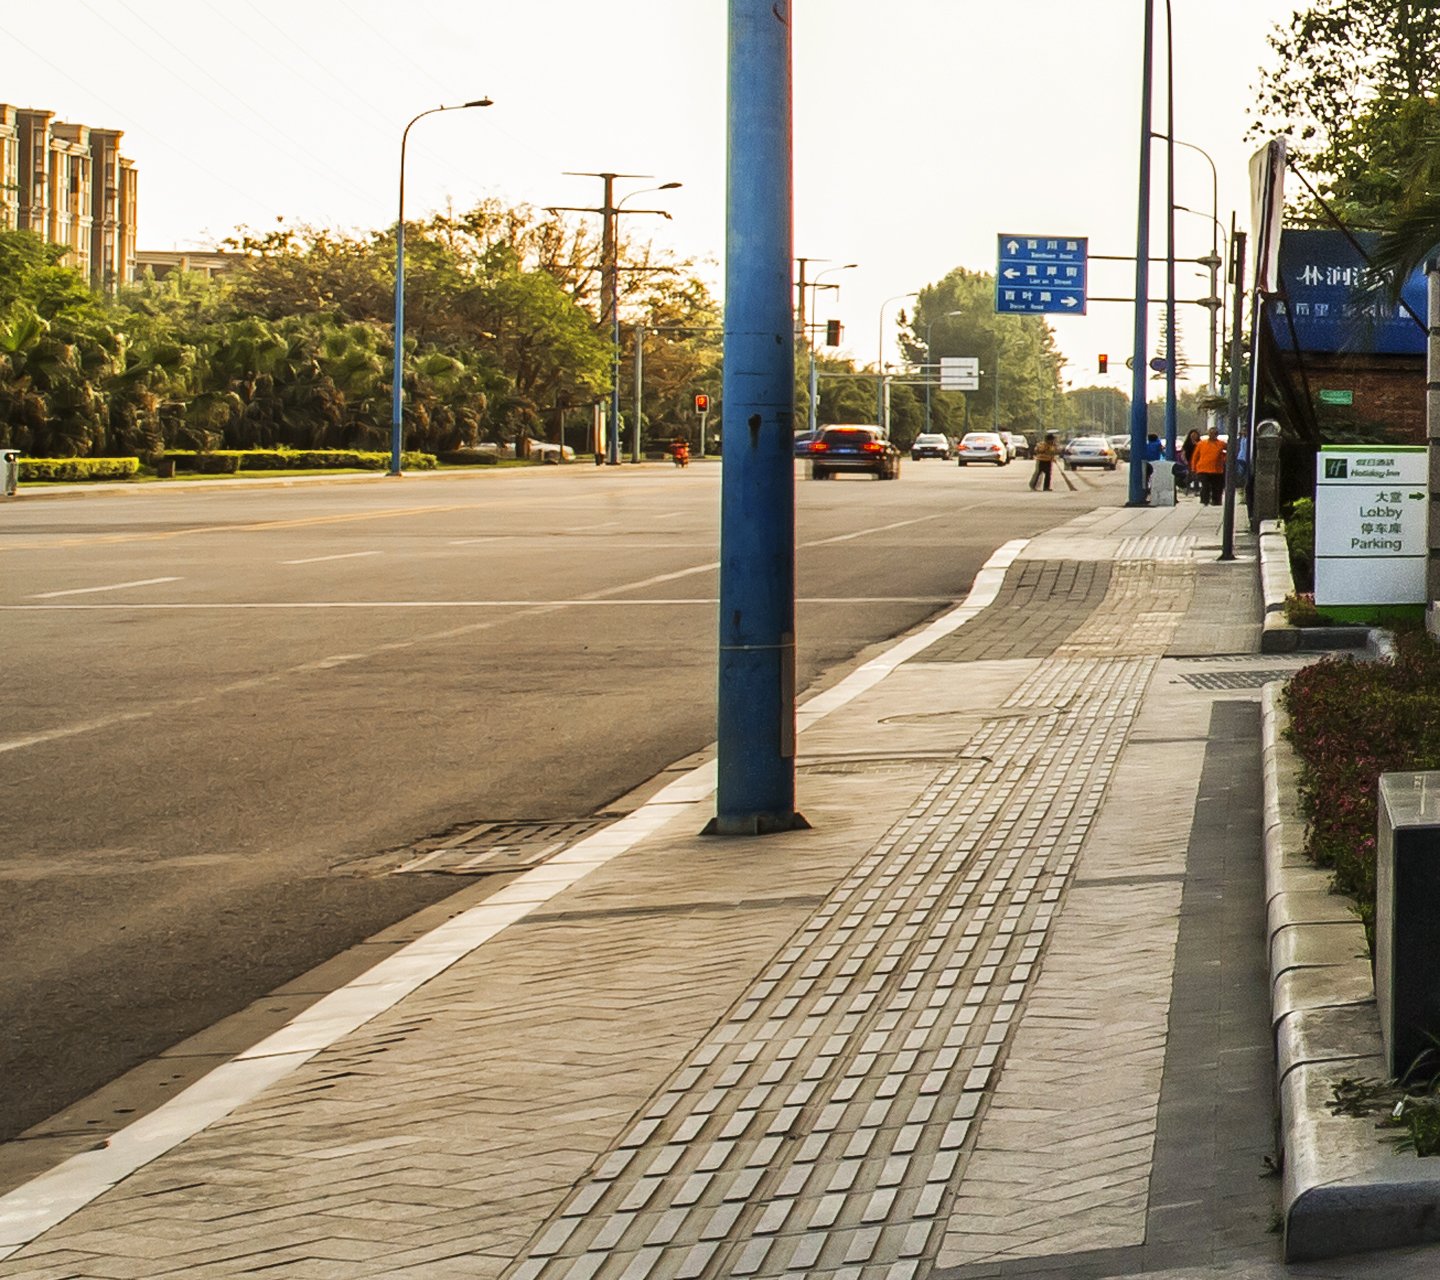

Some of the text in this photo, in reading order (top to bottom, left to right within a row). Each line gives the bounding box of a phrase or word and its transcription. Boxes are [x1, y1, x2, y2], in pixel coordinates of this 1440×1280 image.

[1375, 491, 1403, 504] 大堂
[1359, 506, 1403, 520] Lobby
[1351, 538, 1402, 551] Parking
